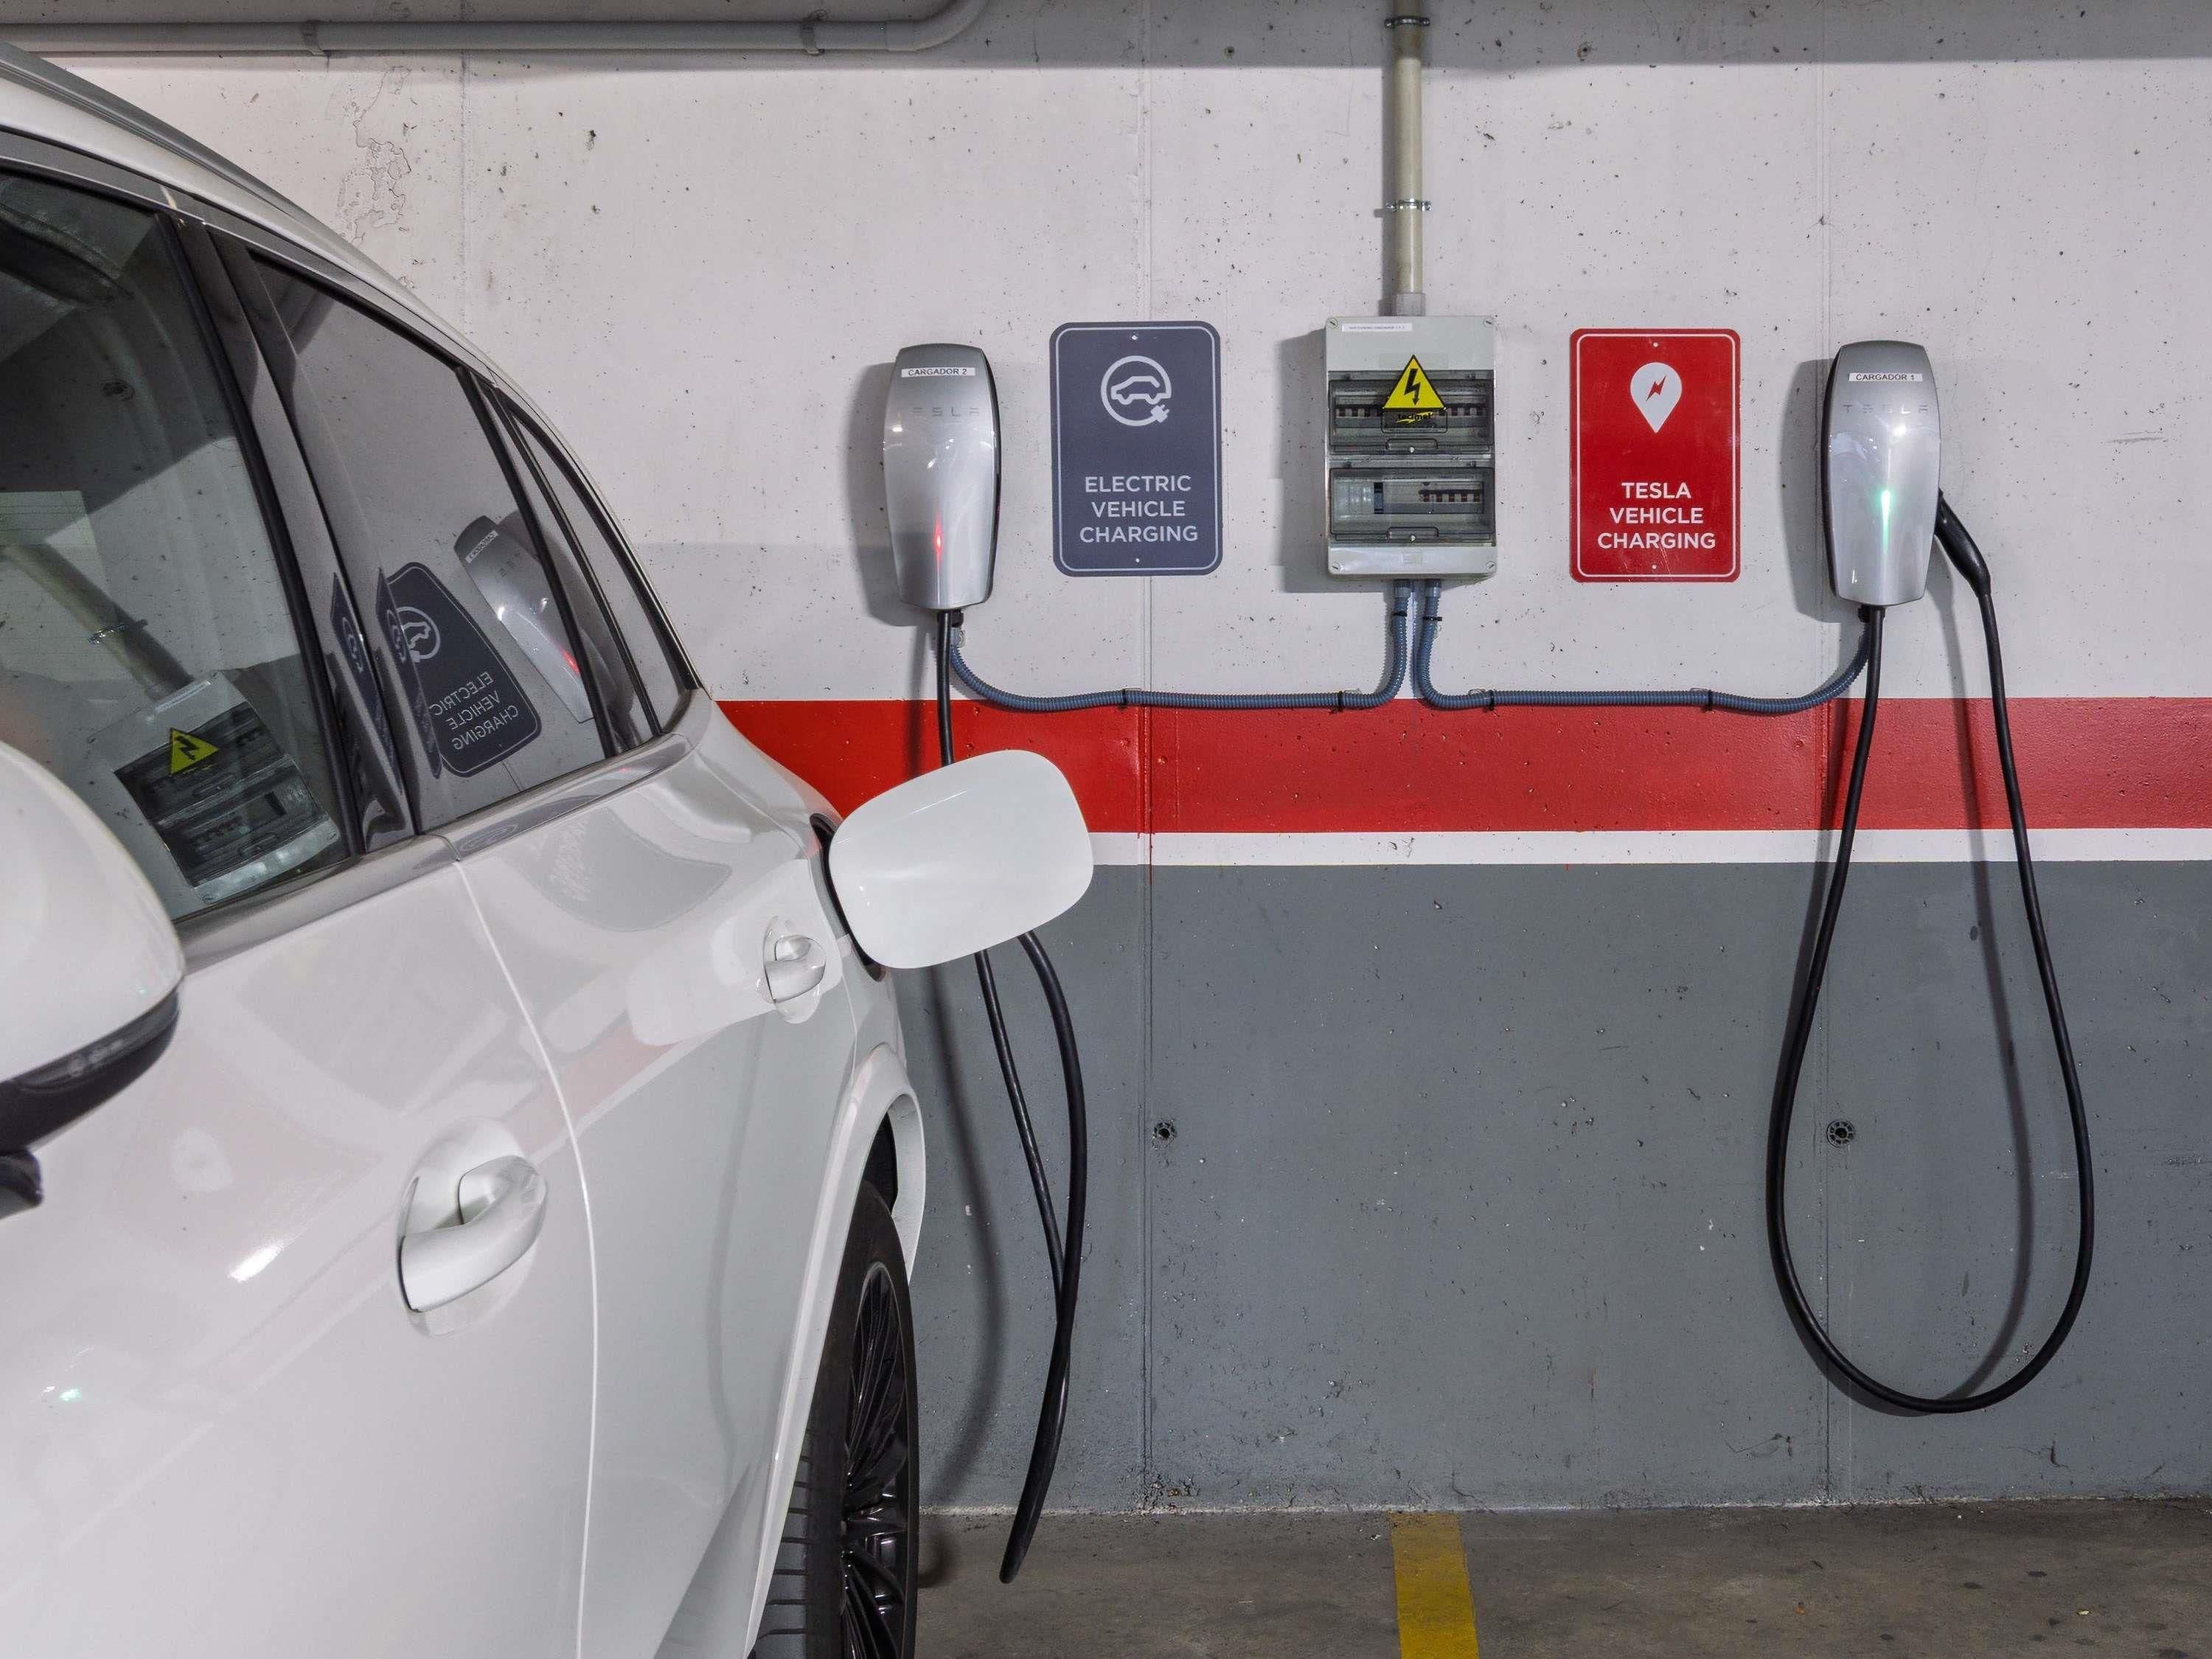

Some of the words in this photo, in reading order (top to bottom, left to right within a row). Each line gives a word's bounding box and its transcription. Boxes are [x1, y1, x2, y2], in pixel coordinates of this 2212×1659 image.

[908, 368, 959, 377] CARGADOR
[911, 406, 980, 417] ESLA
[1085, 475, 1192, 493] ELECTRIC
[1621, 481, 1691, 499] TESLA
[1091, 500, 1186, 518] VEHICLE
[1609, 507, 1704, 524] VEHICLE
[1079, 525, 1198, 543] CHARGING
[1597, 532, 1716, 549] CHARGING
